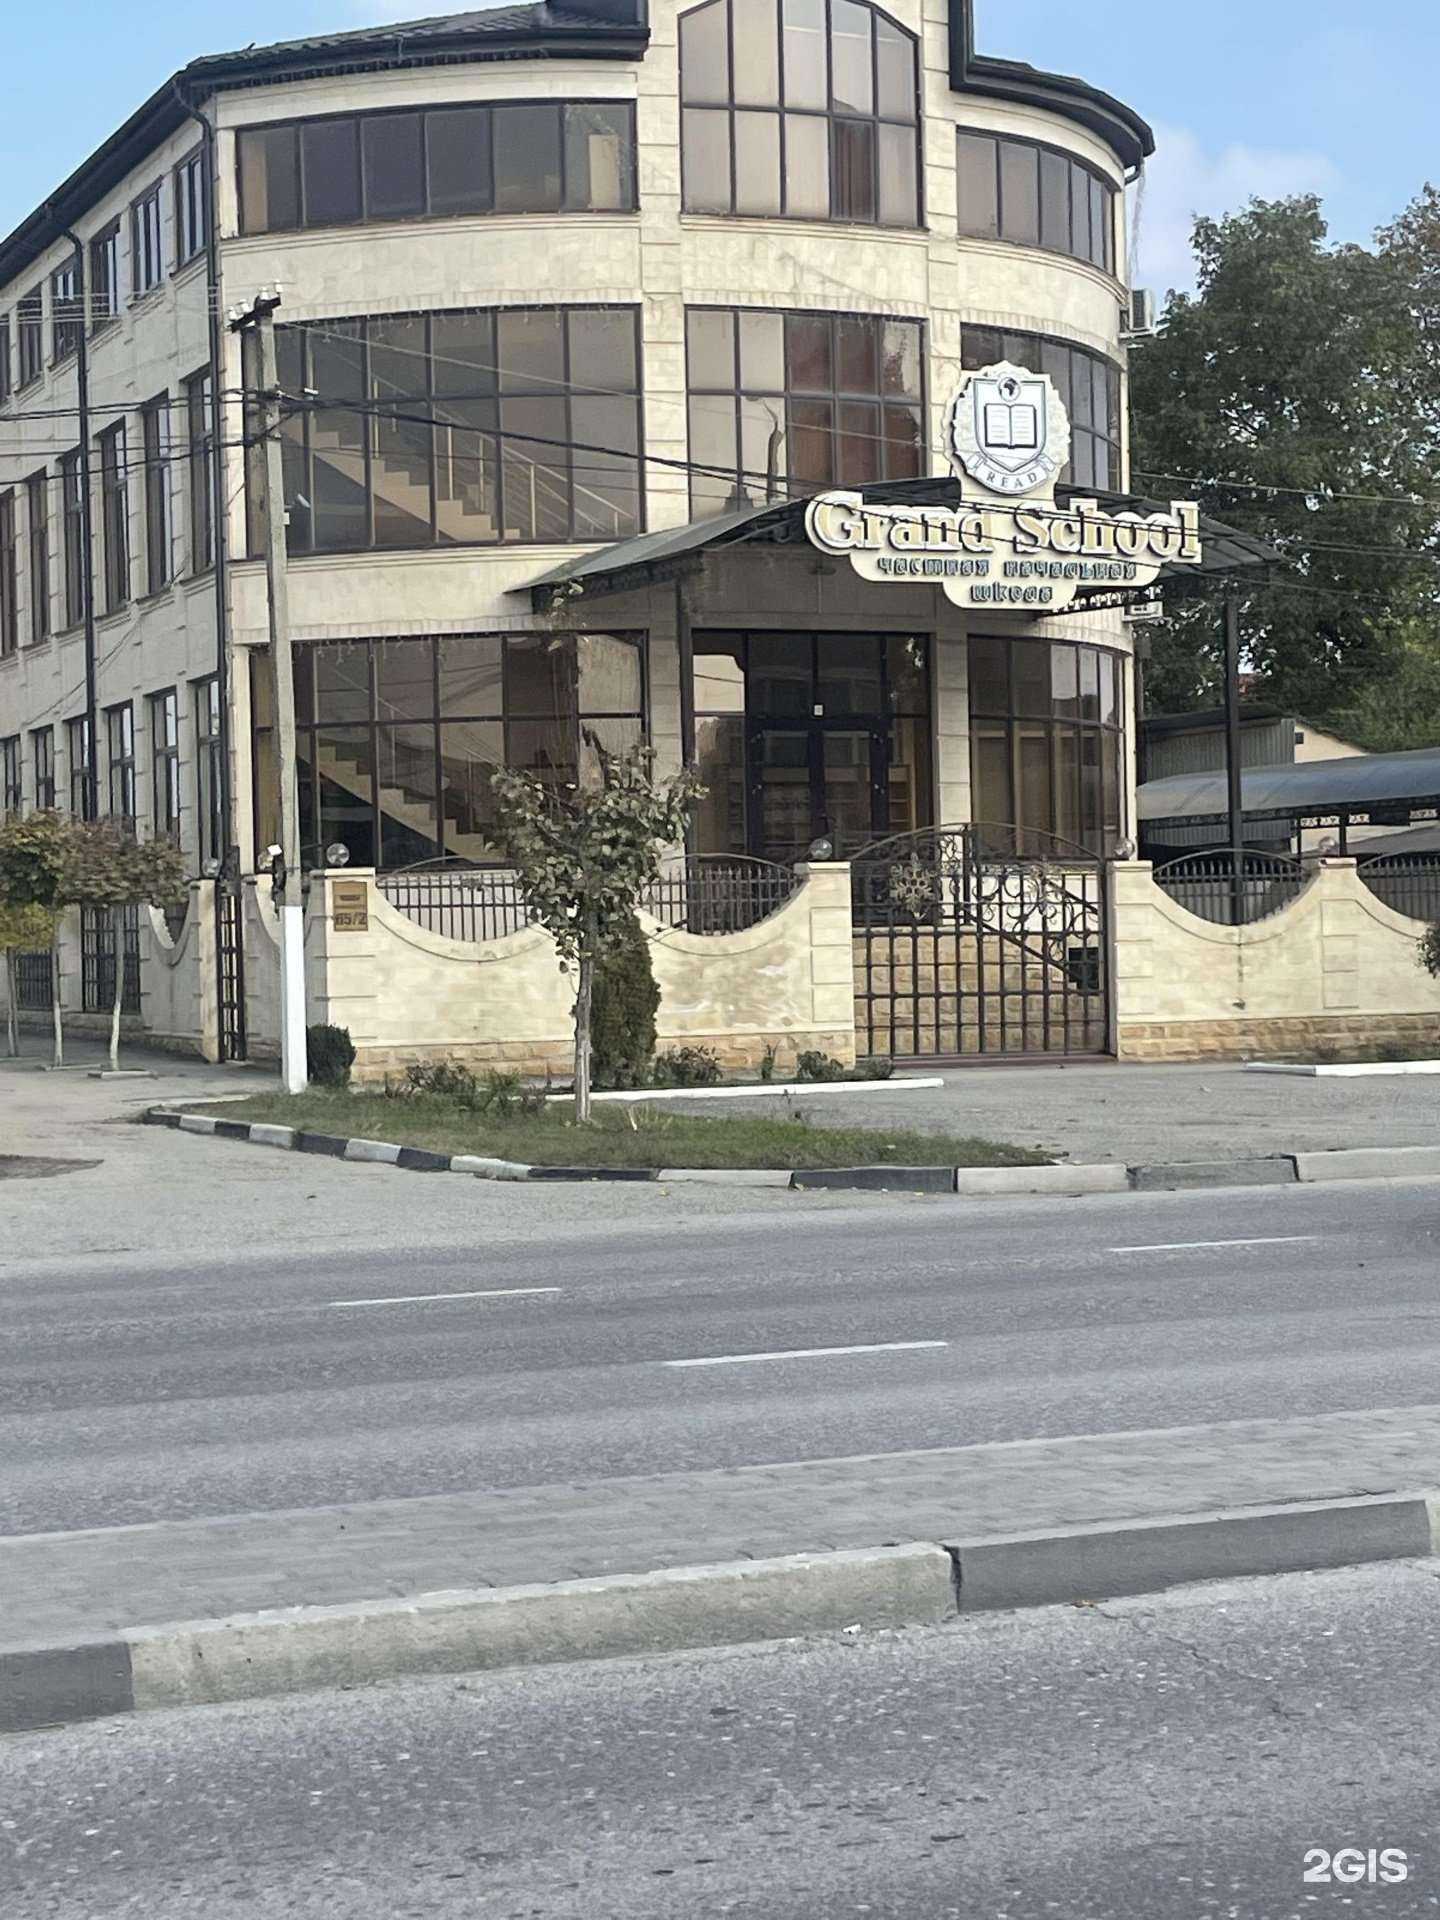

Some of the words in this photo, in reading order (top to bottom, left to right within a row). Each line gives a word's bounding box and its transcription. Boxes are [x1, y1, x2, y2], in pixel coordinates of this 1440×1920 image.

[986, 471, 1038, 489] READ
[813, 498, 994, 551] Grand
[1014, 501, 1202, 557] School
[878, 557, 990, 577] частная
[1003, 559, 1137, 580] начальная
[970, 582, 1053, 603] школа
